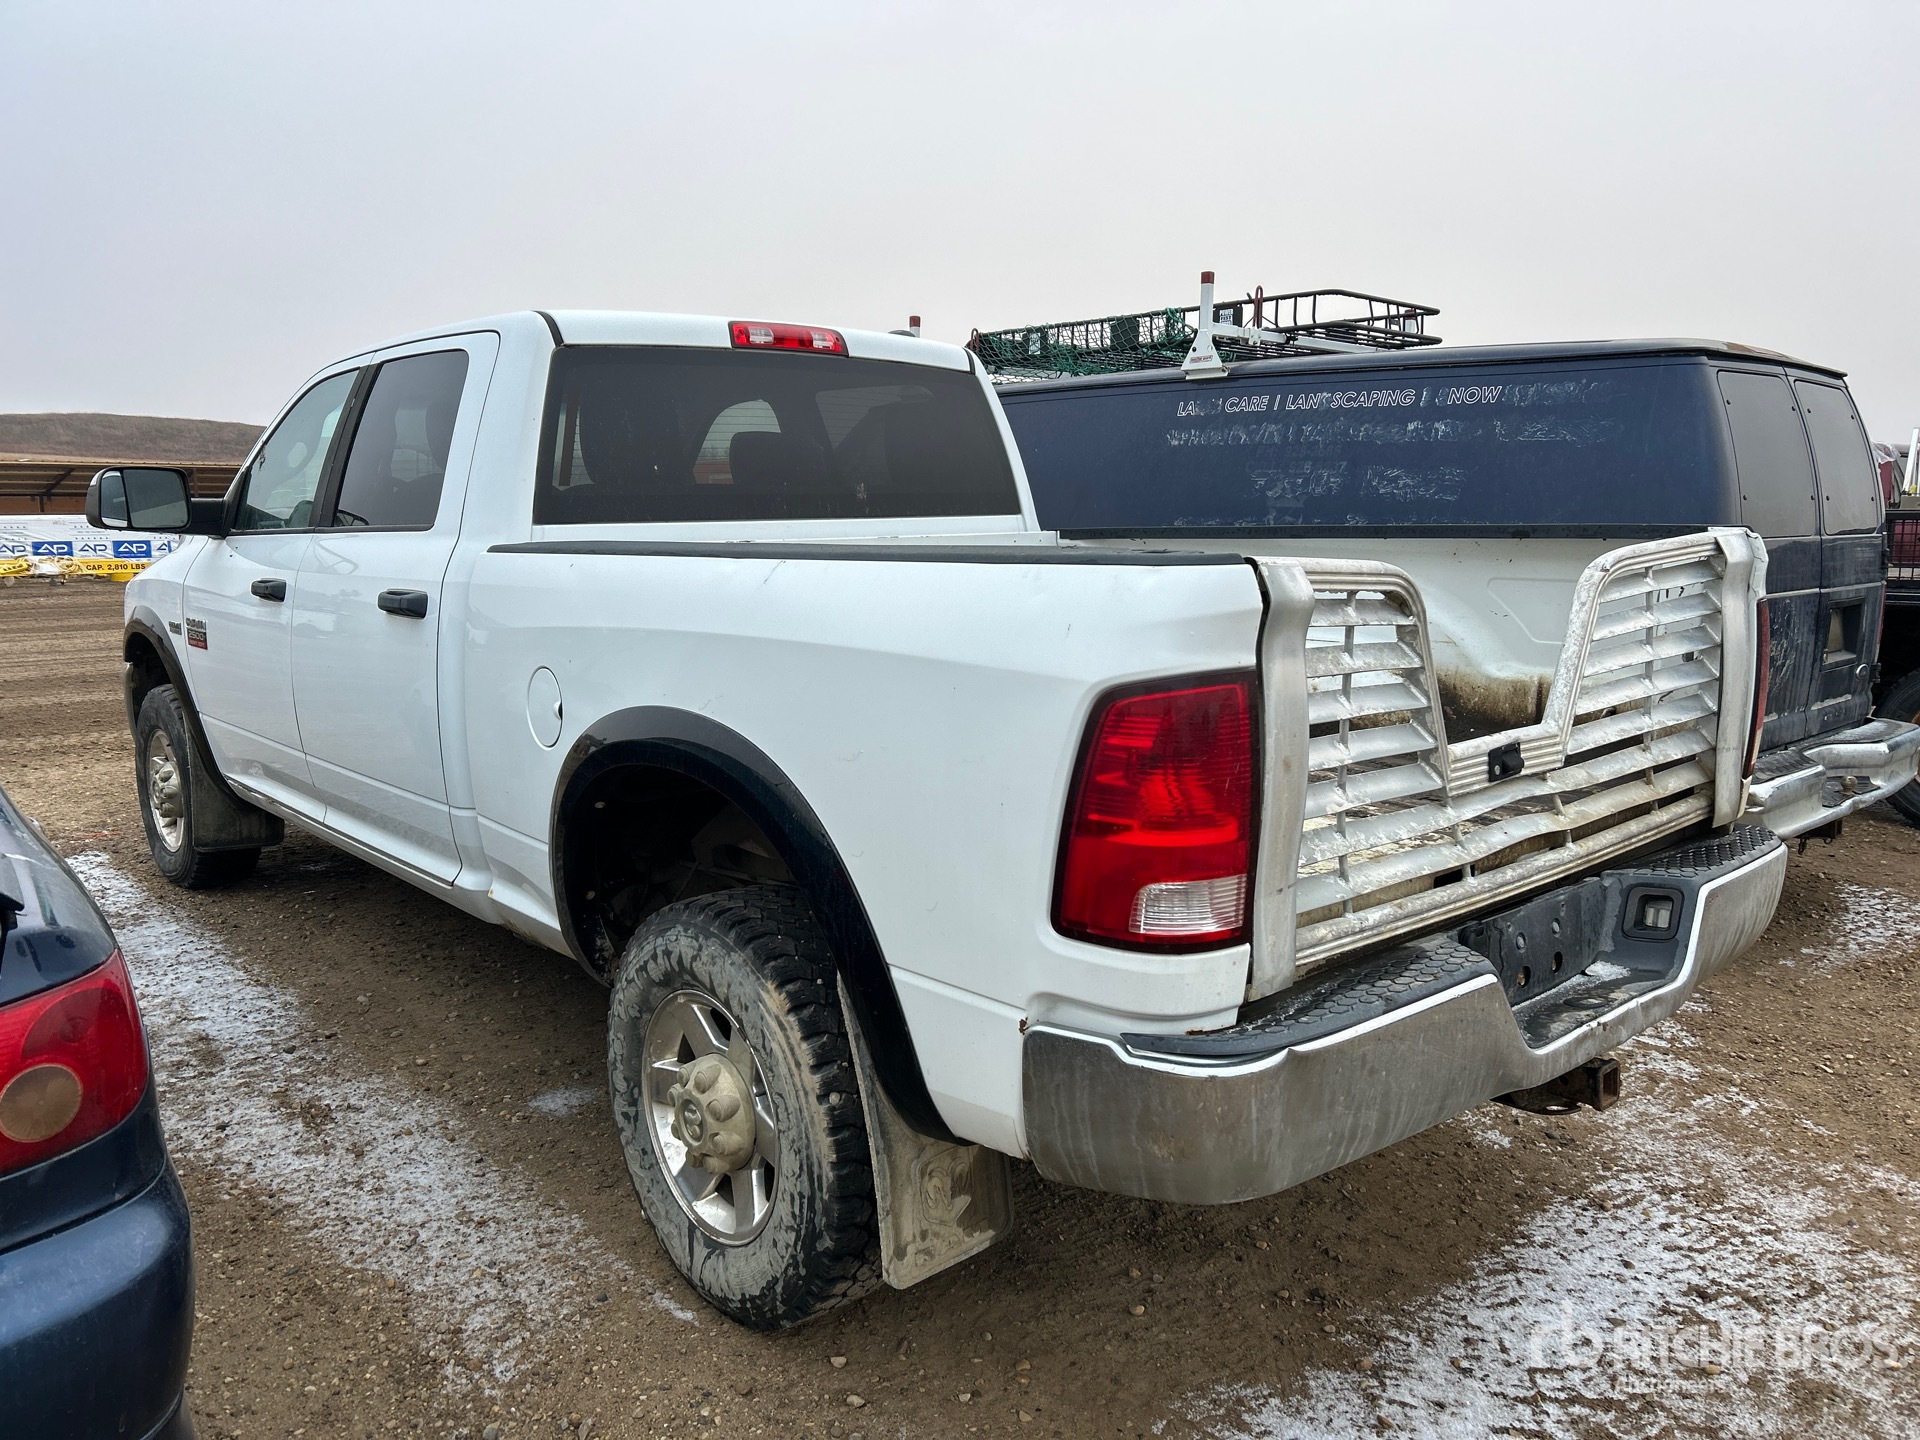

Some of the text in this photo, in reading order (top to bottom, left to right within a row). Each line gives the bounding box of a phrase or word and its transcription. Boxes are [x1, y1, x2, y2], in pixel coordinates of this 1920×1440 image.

[1225, 395, 1269, 413] CARE
[1285, 388, 1416, 411] LANSCAPING
[1435, 385, 1503, 407] NOW
[37, 543, 68, 556] AP
[79, 543, 108, 554] AP
[117, 542, 147, 554] AP
[188, 630, 205, 641] 2500
